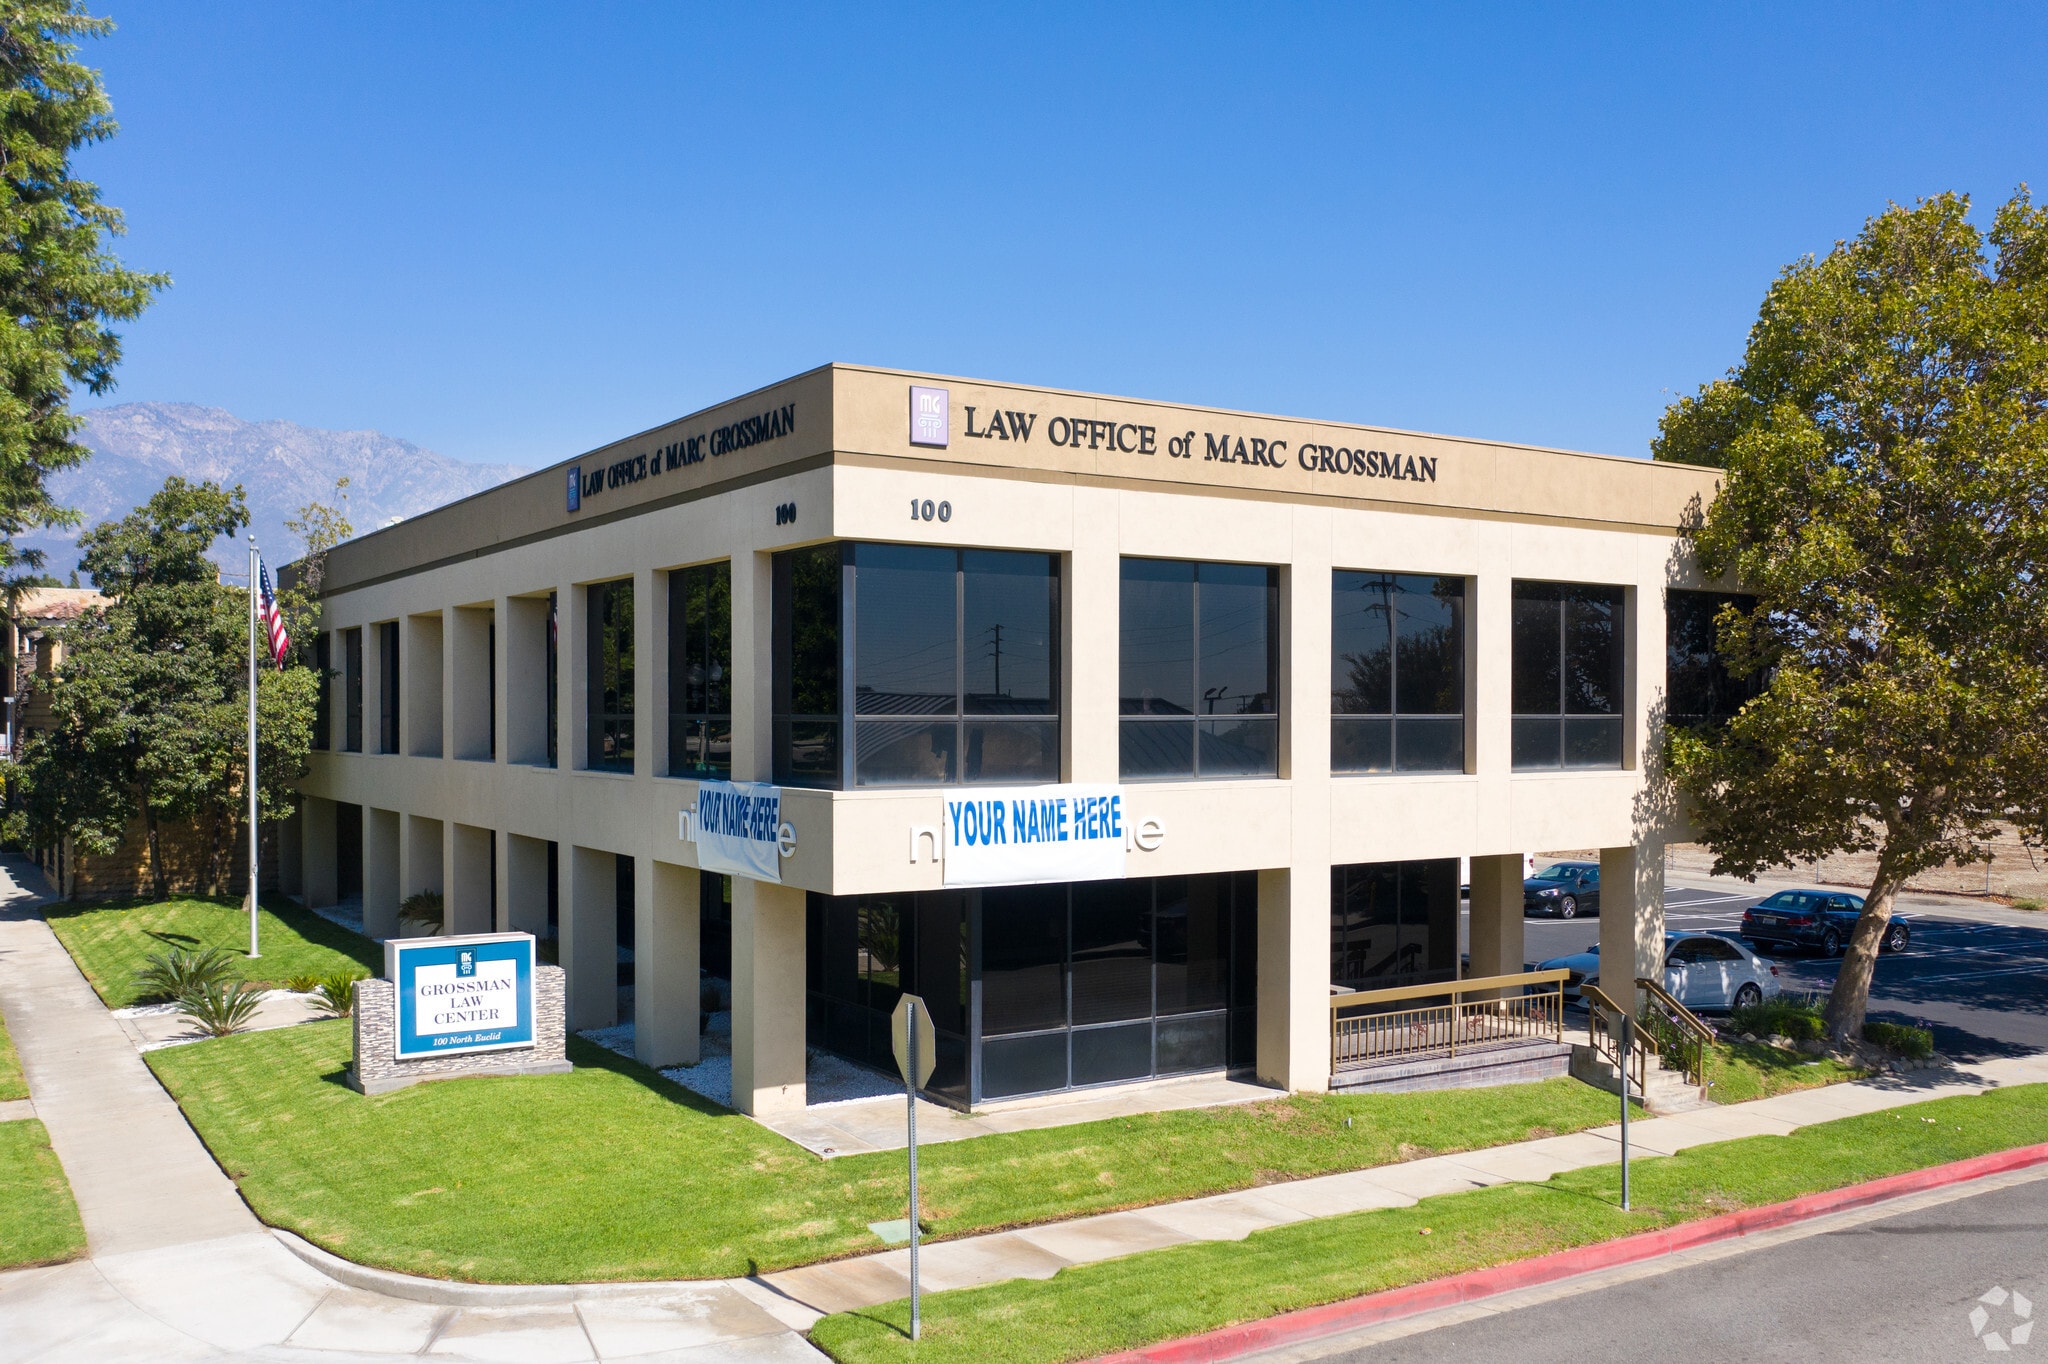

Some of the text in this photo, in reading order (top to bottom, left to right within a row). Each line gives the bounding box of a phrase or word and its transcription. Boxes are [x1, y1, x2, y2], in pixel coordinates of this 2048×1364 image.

[582, 468, 605, 497] LAW
[607, 455, 647, 489] OFFICE
[650, 449, 663, 476] of
[665, 434, 706, 471] MARC
[710, 403, 795, 457] GROSSMAN
[964, 406, 1437, 482] LAW OFFICE of MARC GROSSMAN
[776, 502, 797, 526] 100
[910, 498, 952, 522] 100
[700, 789, 722, 834] YOUR
[723, 792, 751, 838] NAME
[750, 796, 778, 842] HERE
[949, 800, 1007, 847] YOUR
[1012, 798, 1068, 844] NAME
[1072, 795, 1122, 841] HERE
[420, 978, 511, 997] GROSSMAN
[450, 995, 483, 1009] LAW
[434, 1008, 500, 1025] CENTER
[433, 1031, 501, 1046] 100 North Euclid
